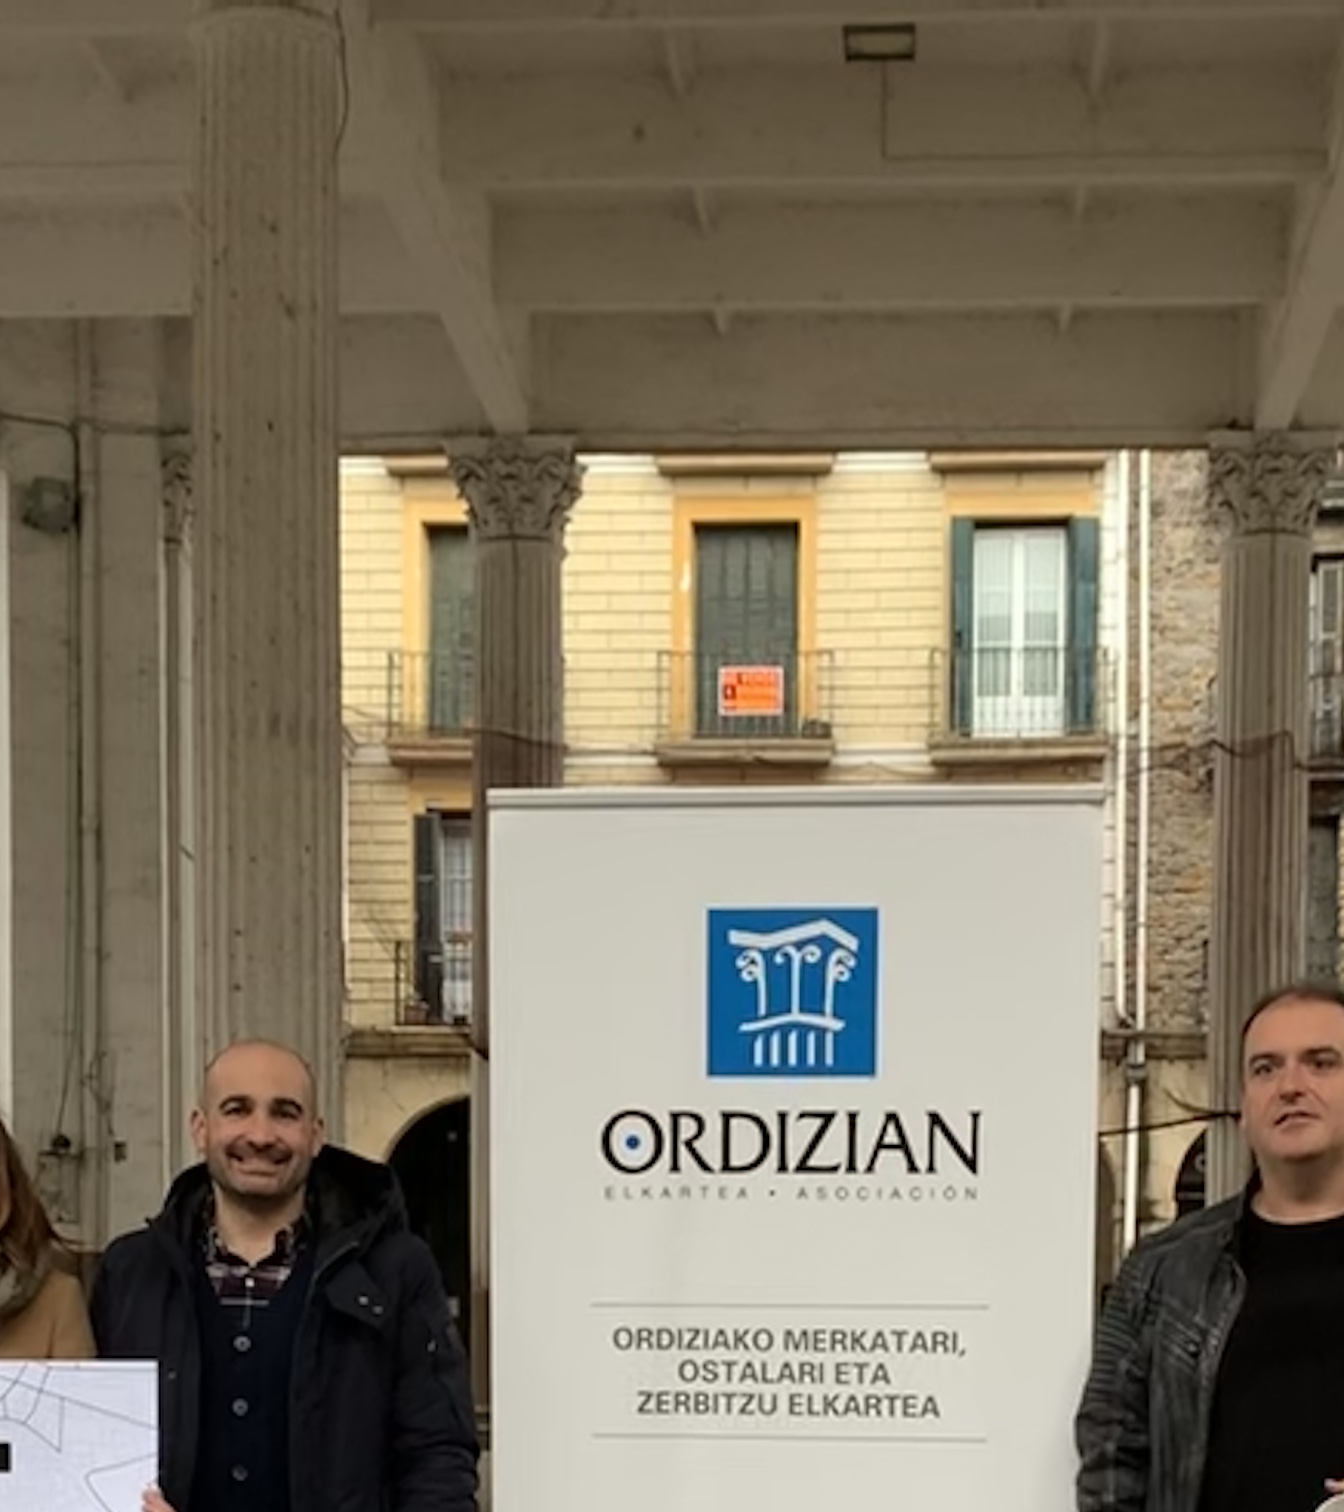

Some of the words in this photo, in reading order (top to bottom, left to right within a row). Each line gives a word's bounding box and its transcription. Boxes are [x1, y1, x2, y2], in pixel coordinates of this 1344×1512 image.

[601, 1109, 981, 1175] ORDIZIAN
[604, 1185, 749, 1201] ELKARTEA
[795, 1183, 978, 1201] ASOCIACIÓN
[612, 1327, 775, 1352] ORDIZIAKO
[782, 1328, 967, 1358] MERKATARI,
[677, 1359, 825, 1385] OSTALARI
[834, 1361, 892, 1386] ETA
[636, 1390, 779, 1416] ZERBITZU
[788, 1392, 941, 1419] ELKARTEA
